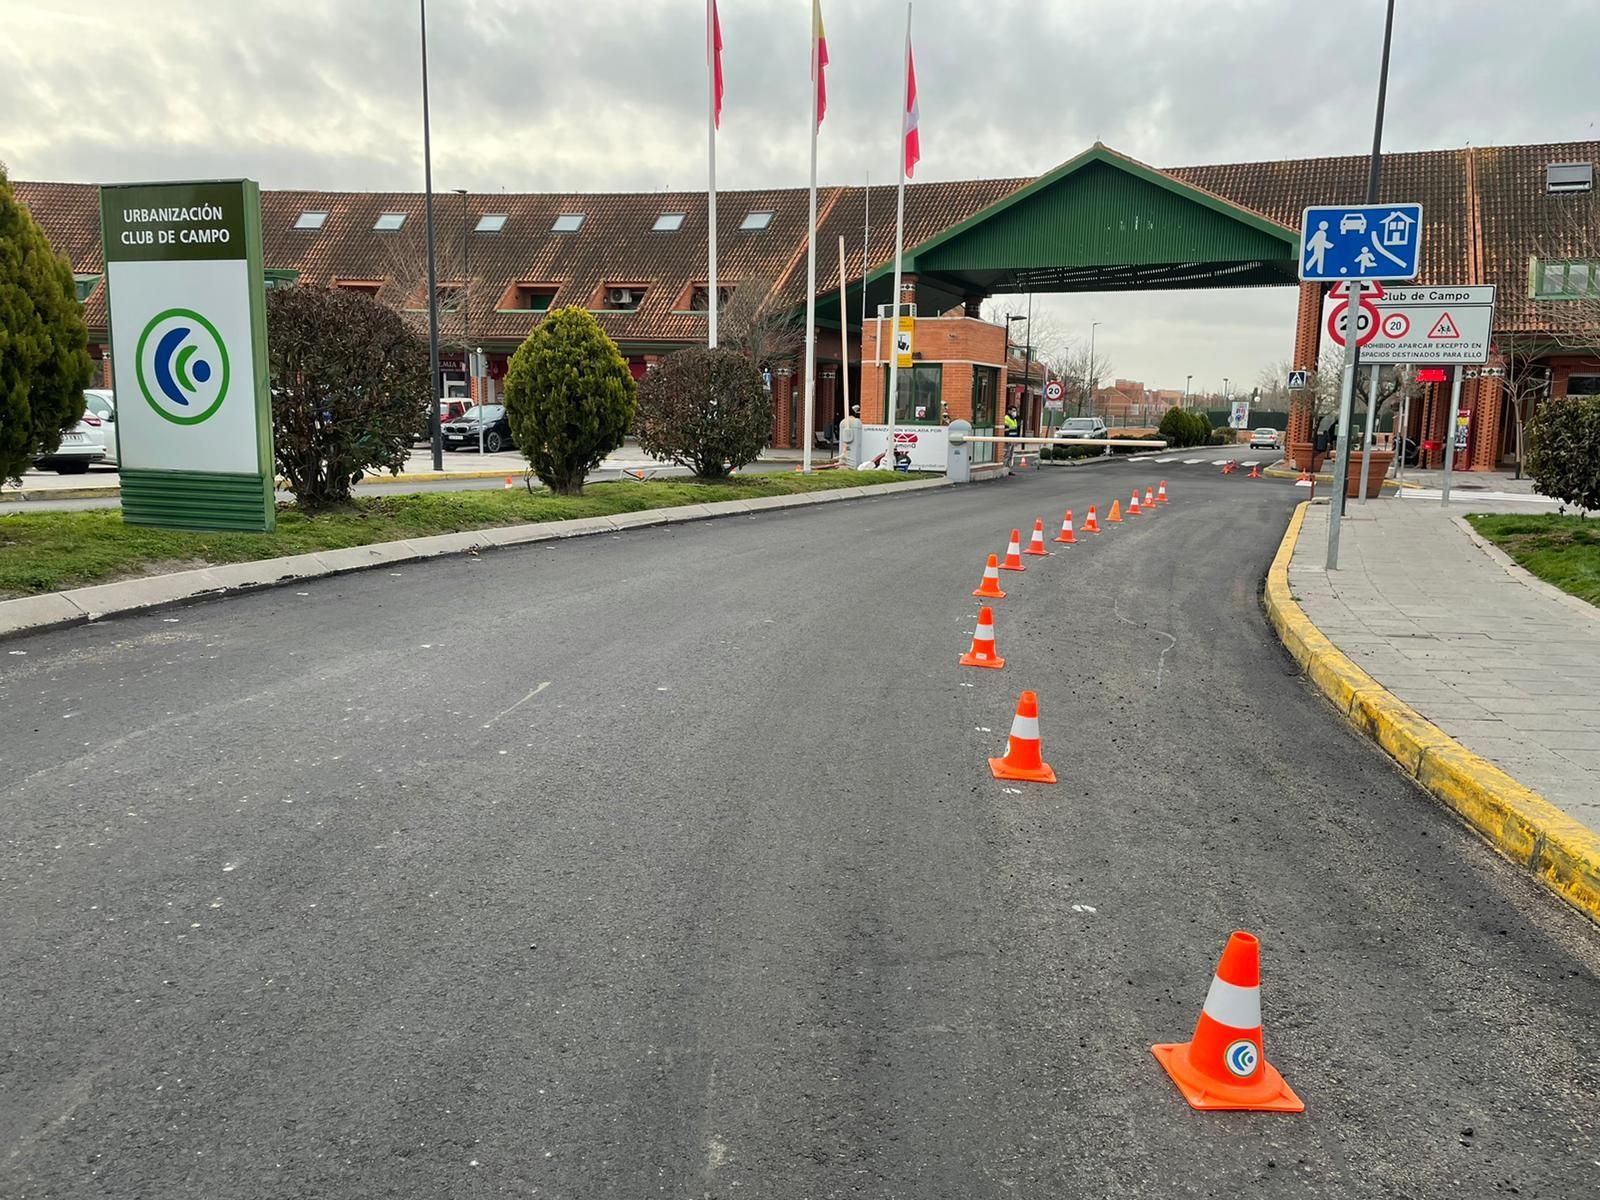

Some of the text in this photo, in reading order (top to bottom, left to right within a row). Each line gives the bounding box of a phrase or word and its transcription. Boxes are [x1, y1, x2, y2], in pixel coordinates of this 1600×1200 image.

[123, 203, 223, 222] URBANIZACIÓN
[121, 228, 230, 245] CLUB DE CAMPO
[1411, 291, 1425, 301] de
[1428, 291, 1470, 302] Campo
[1340, 314, 1369, 331] 20
[1390, 321, 1402, 331] 20
